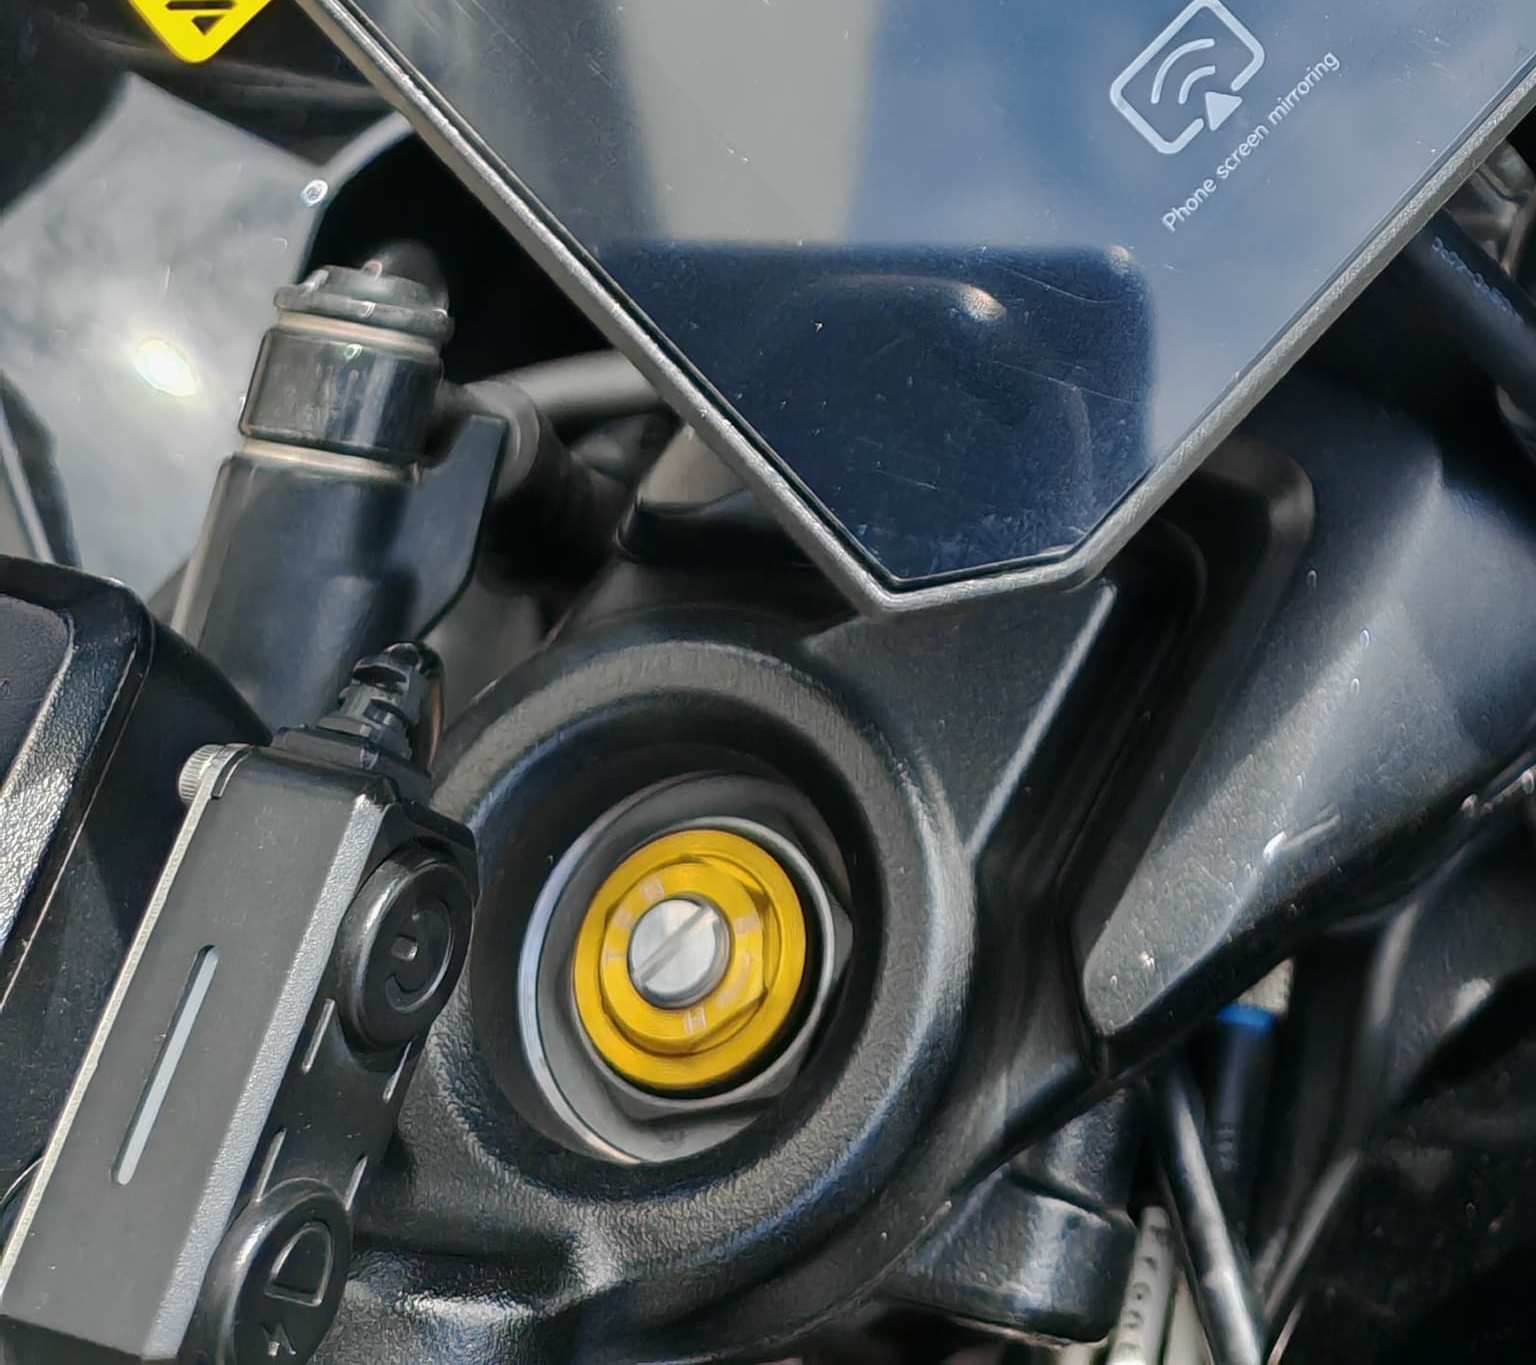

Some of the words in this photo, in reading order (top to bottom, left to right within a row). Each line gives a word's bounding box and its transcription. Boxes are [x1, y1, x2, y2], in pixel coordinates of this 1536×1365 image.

[1161, 178, 1216, 232] Phone
[1216, 123, 1269, 179] screen
[1268, 52, 1341, 125] mirroring
